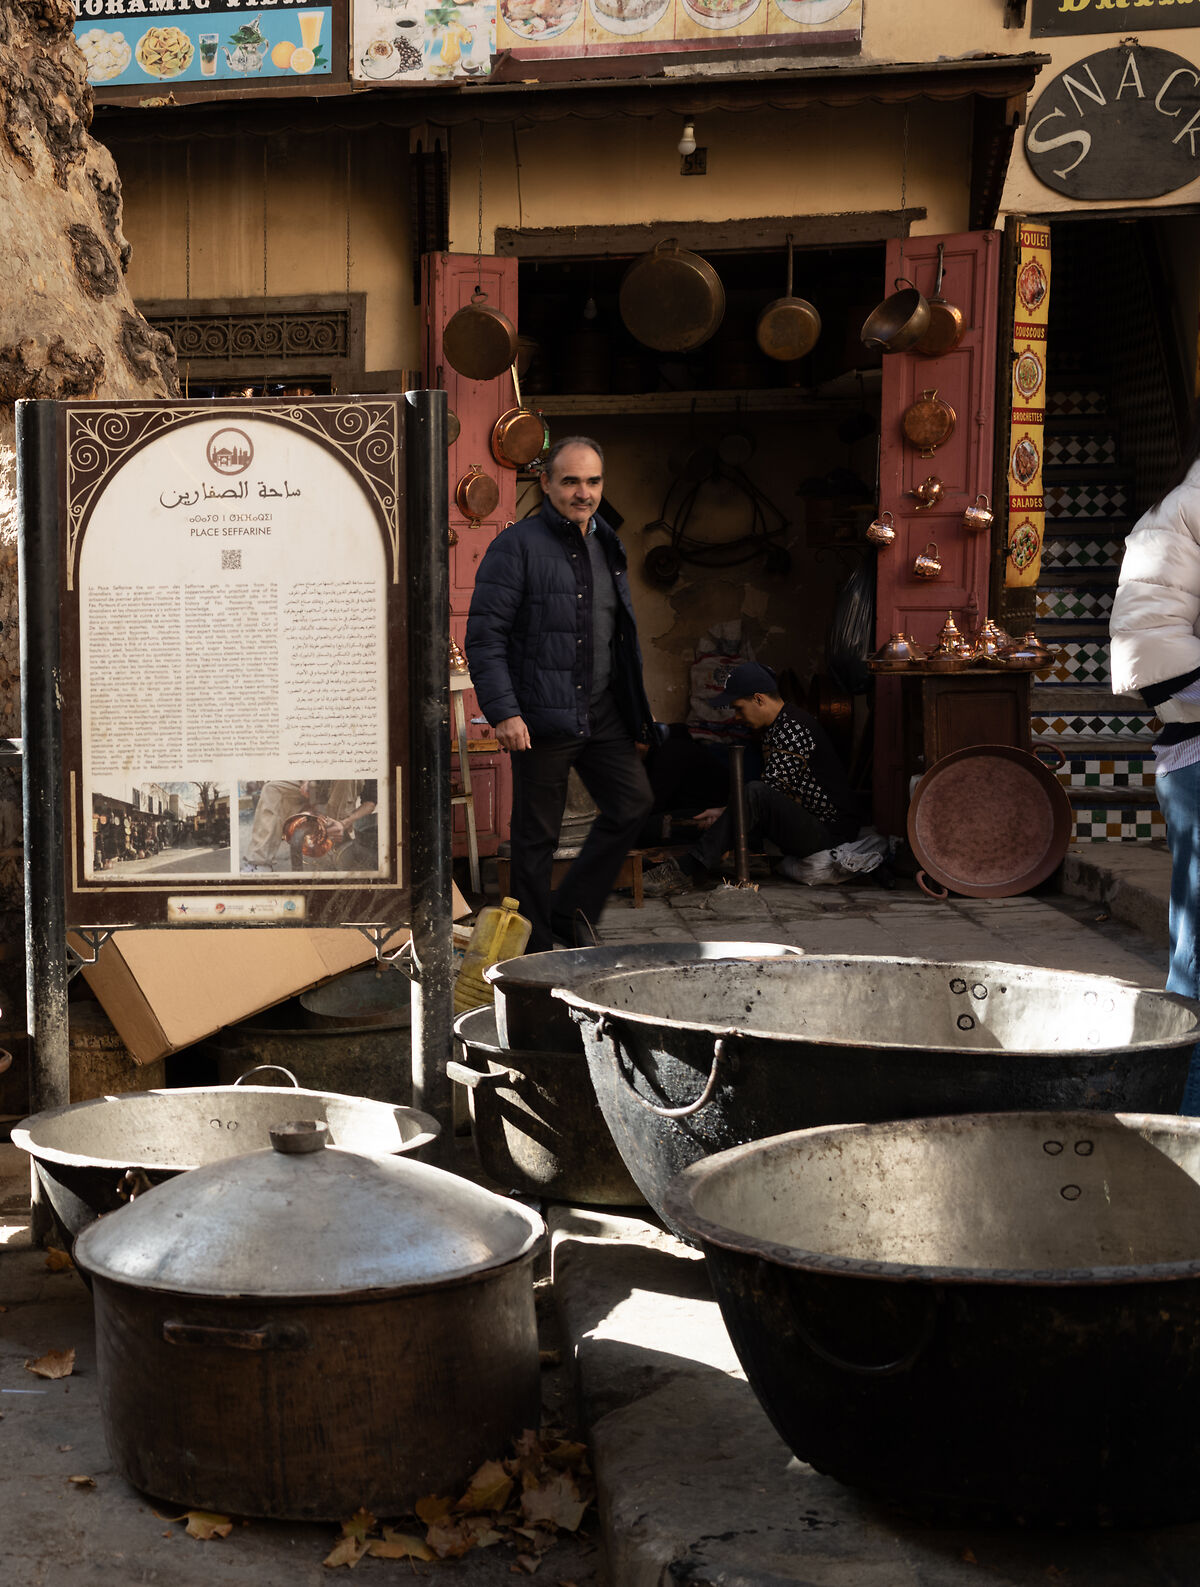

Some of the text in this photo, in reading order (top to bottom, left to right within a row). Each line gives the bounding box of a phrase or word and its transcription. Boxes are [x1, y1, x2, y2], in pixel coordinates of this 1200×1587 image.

[1016, 326, 1045, 338] COUSCOUS
[1013, 412, 1043, 422] BROCHETTES
[159, 480, 301, 509] ساحة الصفارين
[1011, 498, 1043, 508] SALADES
[190, 526, 272, 537] PLACE SEFFARINE
